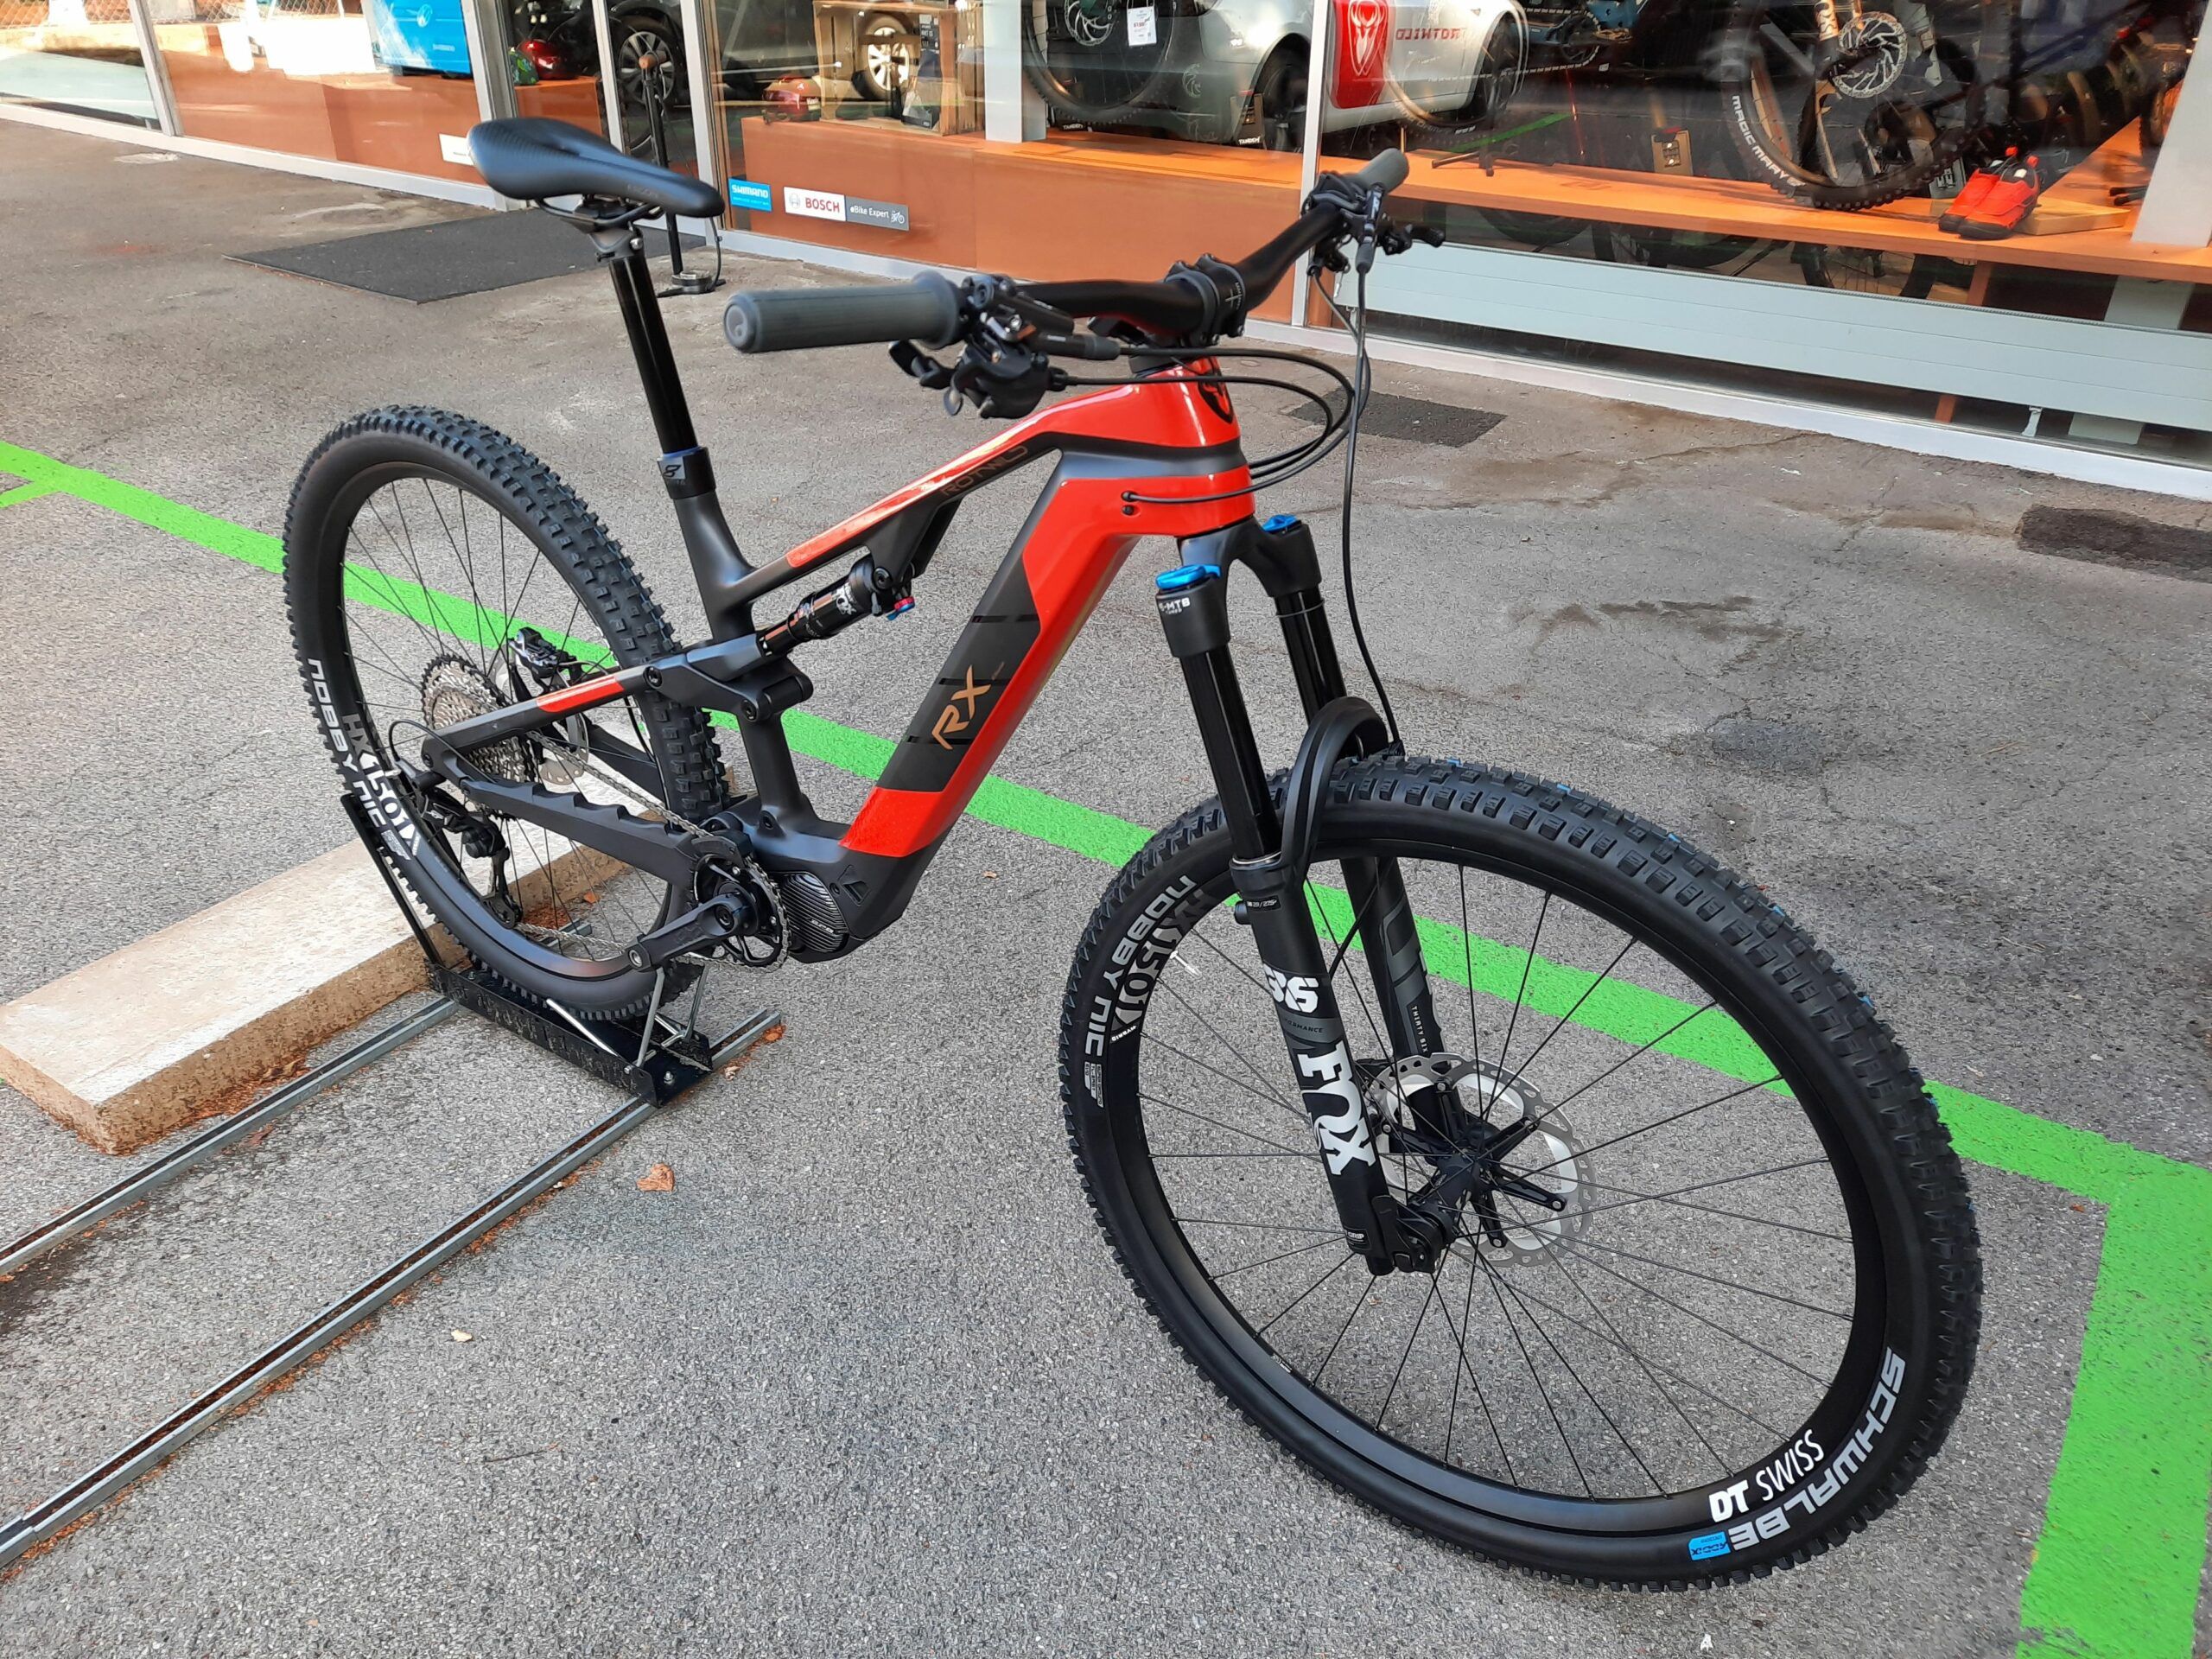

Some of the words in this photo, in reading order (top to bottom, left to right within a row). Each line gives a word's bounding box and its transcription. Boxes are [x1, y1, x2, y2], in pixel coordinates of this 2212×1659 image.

[1732, 95, 1757, 145] MAGIC
[1752, 145, 1789, 179] MARY
[731, 184, 769, 199] SHIMANO
[804, 197, 840, 213] BOSCH
[849, 205, 868, 215] eBike
[868, 207, 890, 219] Expert
[308, 658, 359, 772] NOBBY
[353, 780, 387, 827] NIC
[931, 664, 992, 750] RX
[1103, 874, 1198, 990] NOBBY
[1084, 995, 1112, 1057] NIC
[1262, 963, 1319, 1014] 36
[1411, 1005, 1425, 1035] THIRTY
[1419, 1036, 1429, 1053] SIX
[1297, 1039, 1376, 1176] FOX
[1707, 1480, 1751, 1523] DT
[1755, 1428, 1825, 1501] SWISS
[1727, 1345, 1907, 1551] SCHWALBE
